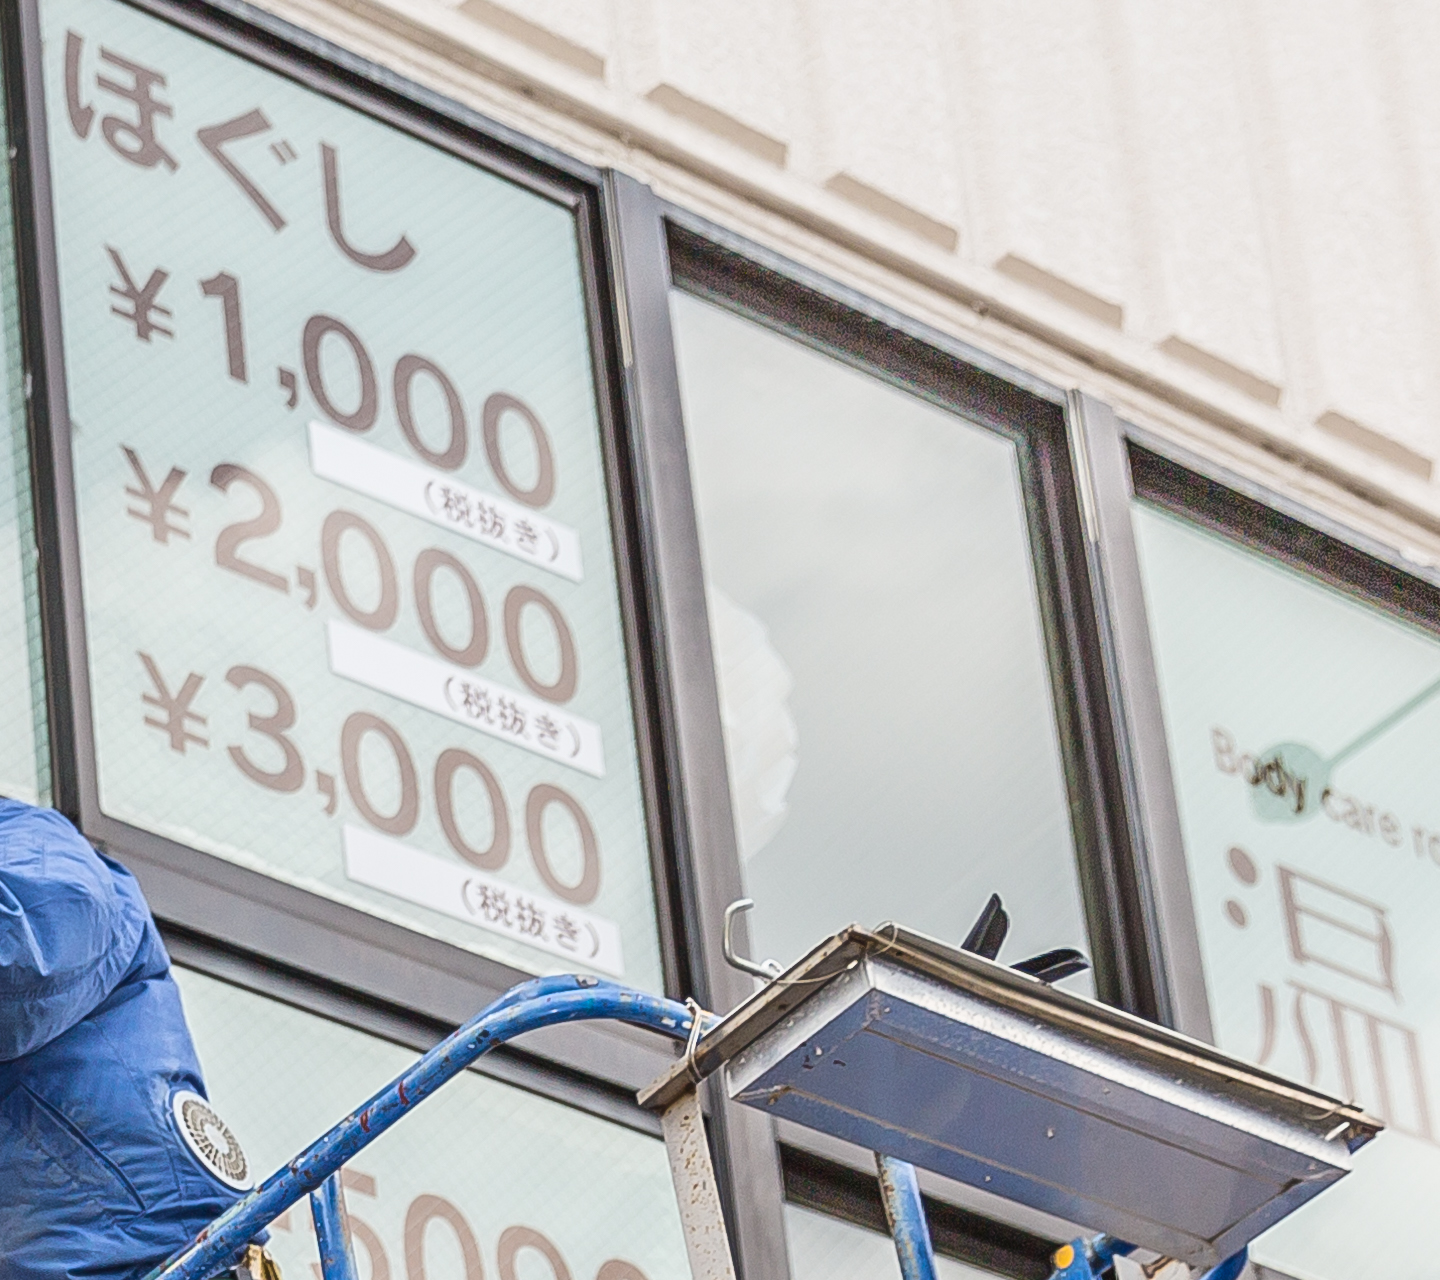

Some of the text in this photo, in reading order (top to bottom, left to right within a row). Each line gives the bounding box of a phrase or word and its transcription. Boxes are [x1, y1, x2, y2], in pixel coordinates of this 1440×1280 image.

[65, 30, 417, 273] ほぐし
[104, 245, 556, 508] ¥1,000
[120, 444, 579, 705] ¥2,000
[425, 480, 560, 563] (税抜き)
[139, 650, 602, 908] ¥3,000
[443, 676, 581, 760] (税抜き)
[1209, 726, 1309, 814] Body
[1320, 784, 1401, 848] care
[461, 878, 601, 960] (税抜き)
